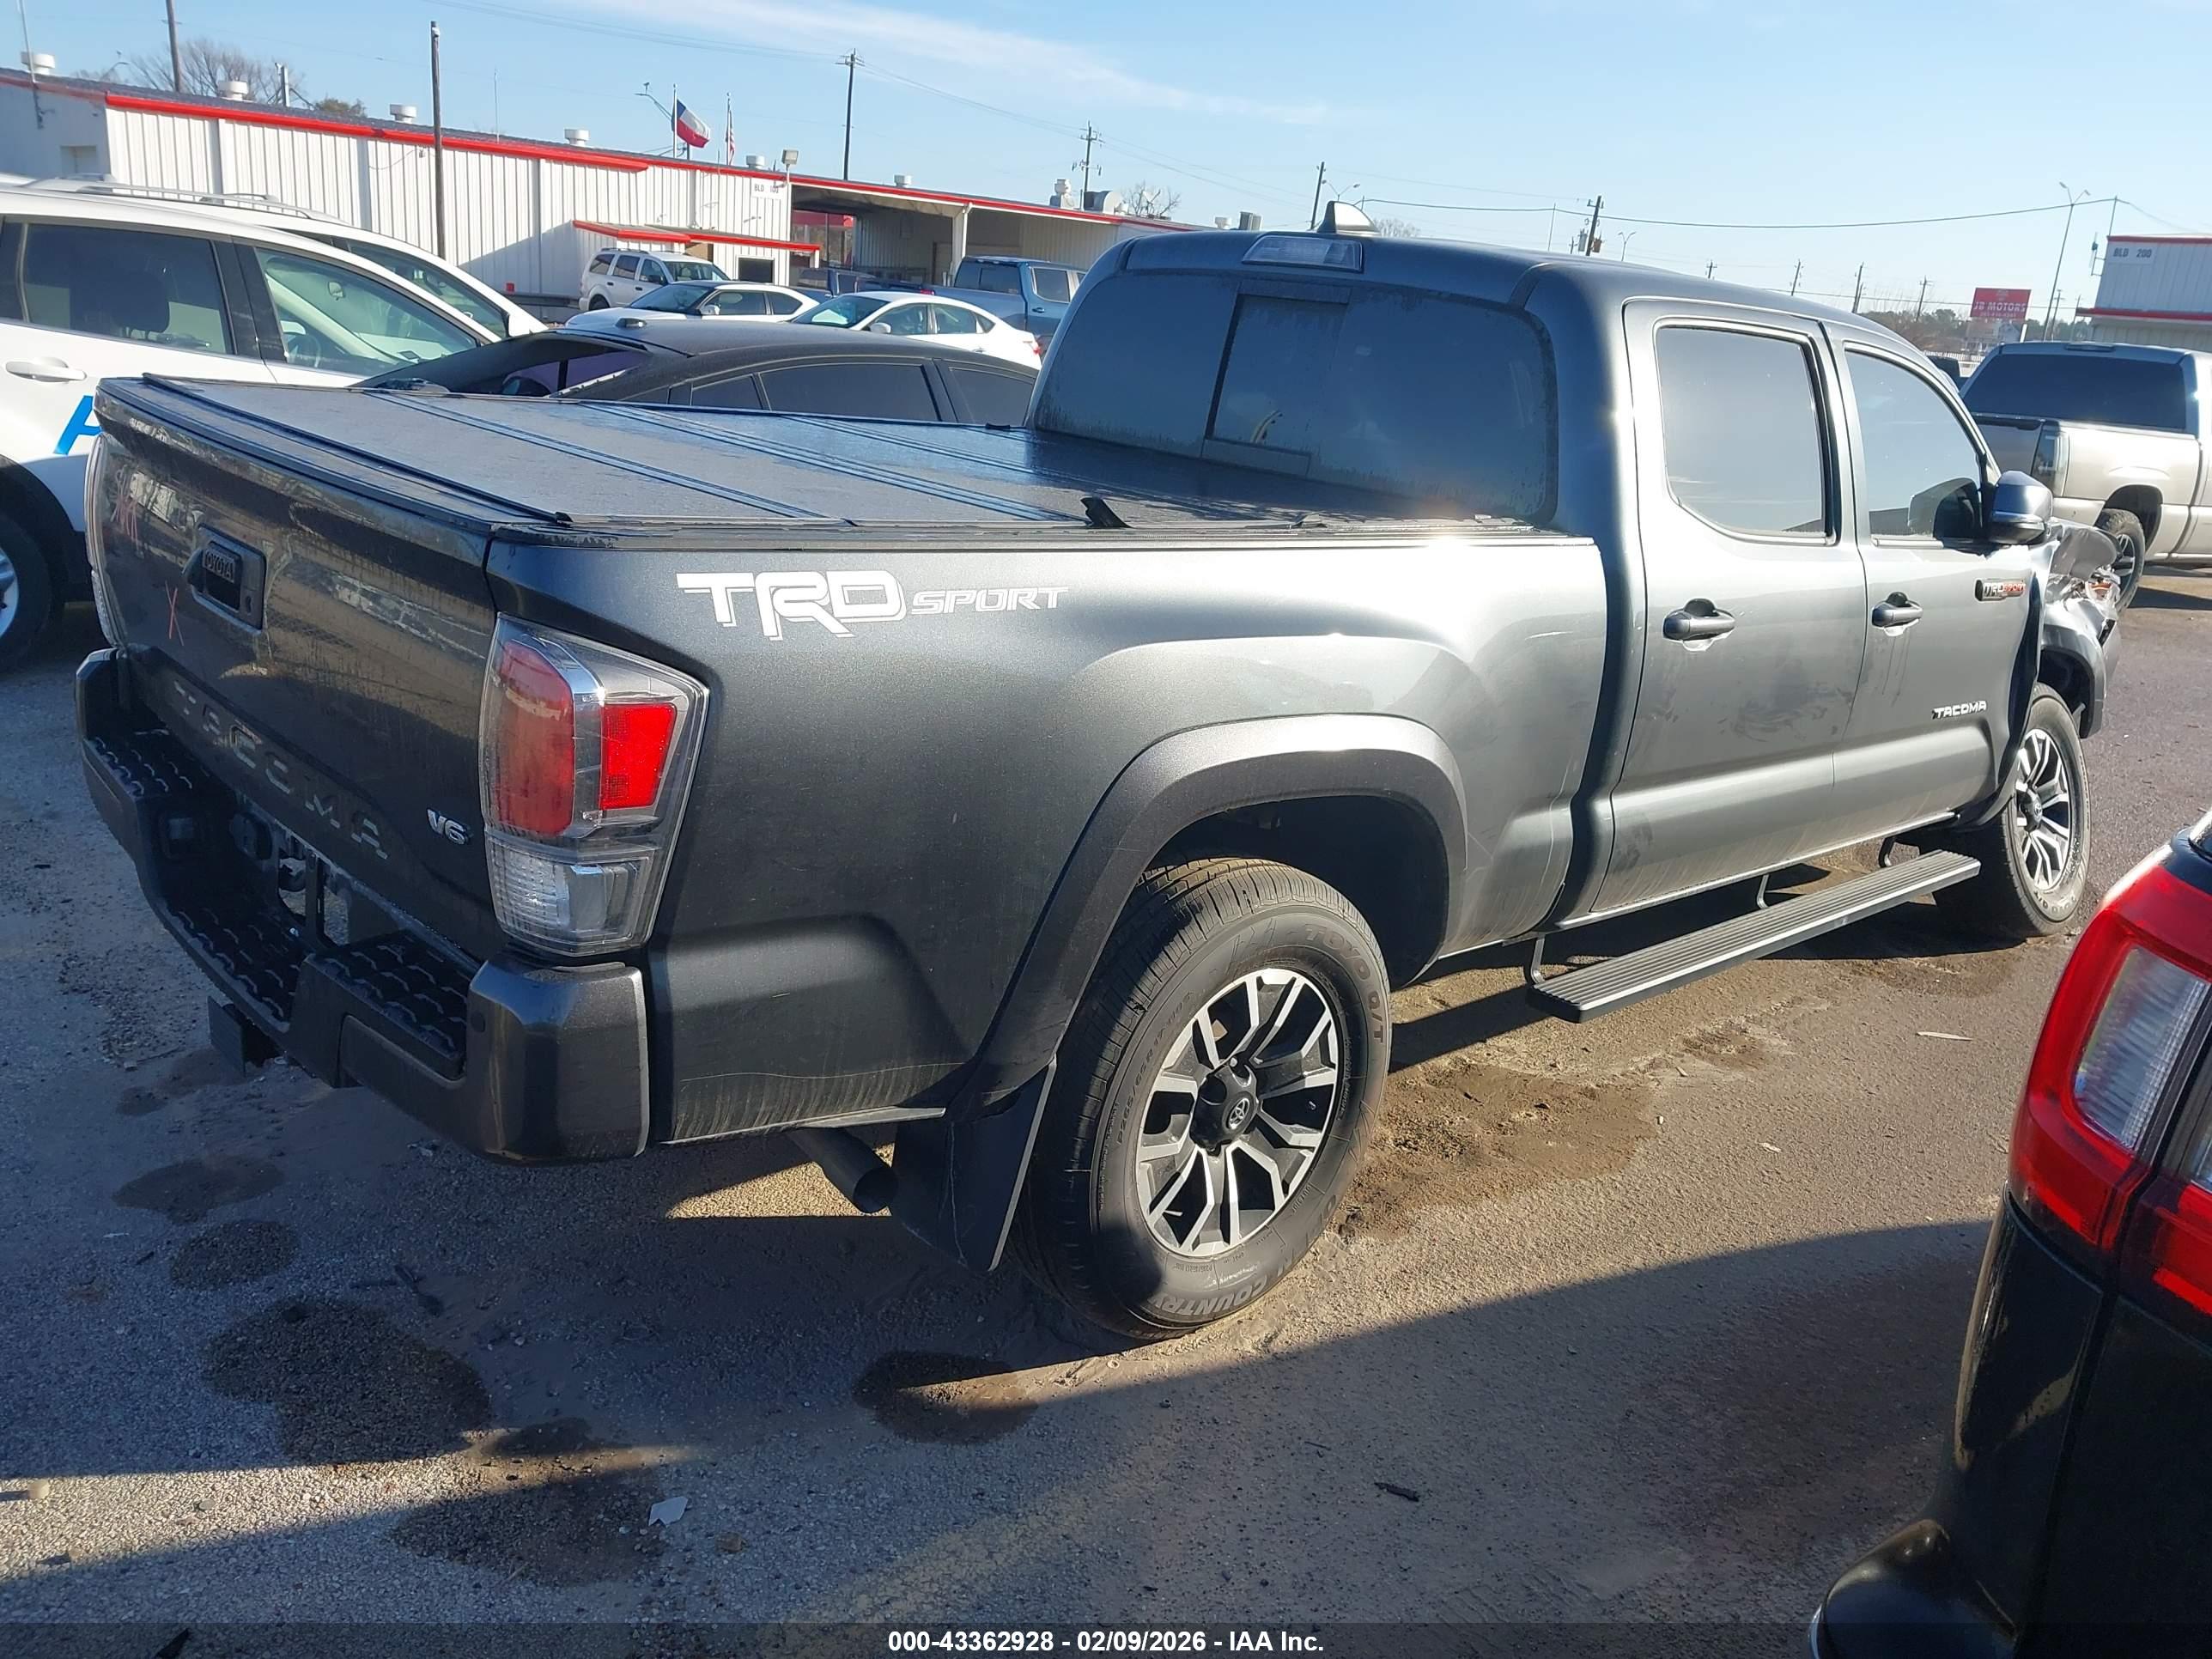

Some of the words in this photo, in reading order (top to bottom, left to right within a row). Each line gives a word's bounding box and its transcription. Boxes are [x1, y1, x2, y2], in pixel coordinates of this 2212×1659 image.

[2113, 247, 2129, 257] BLD
[2136, 248, 2153, 258] 200
[1973, 301, 1985, 310] JB
[1988, 301, 2027, 313] MOTORS
[202, 549, 234, 584] TOYOTA
[677, 569, 908, 641] TRD
[910, 586, 1069, 615] SPORT
[1983, 582, 2003, 597] TRD
[1933, 700, 1987, 720] TACOMA
[427, 808, 466, 845] V6
[1304, 923, 1371, 981] TOYO
[1147, 1275, 1267, 1316] COUNTRY
